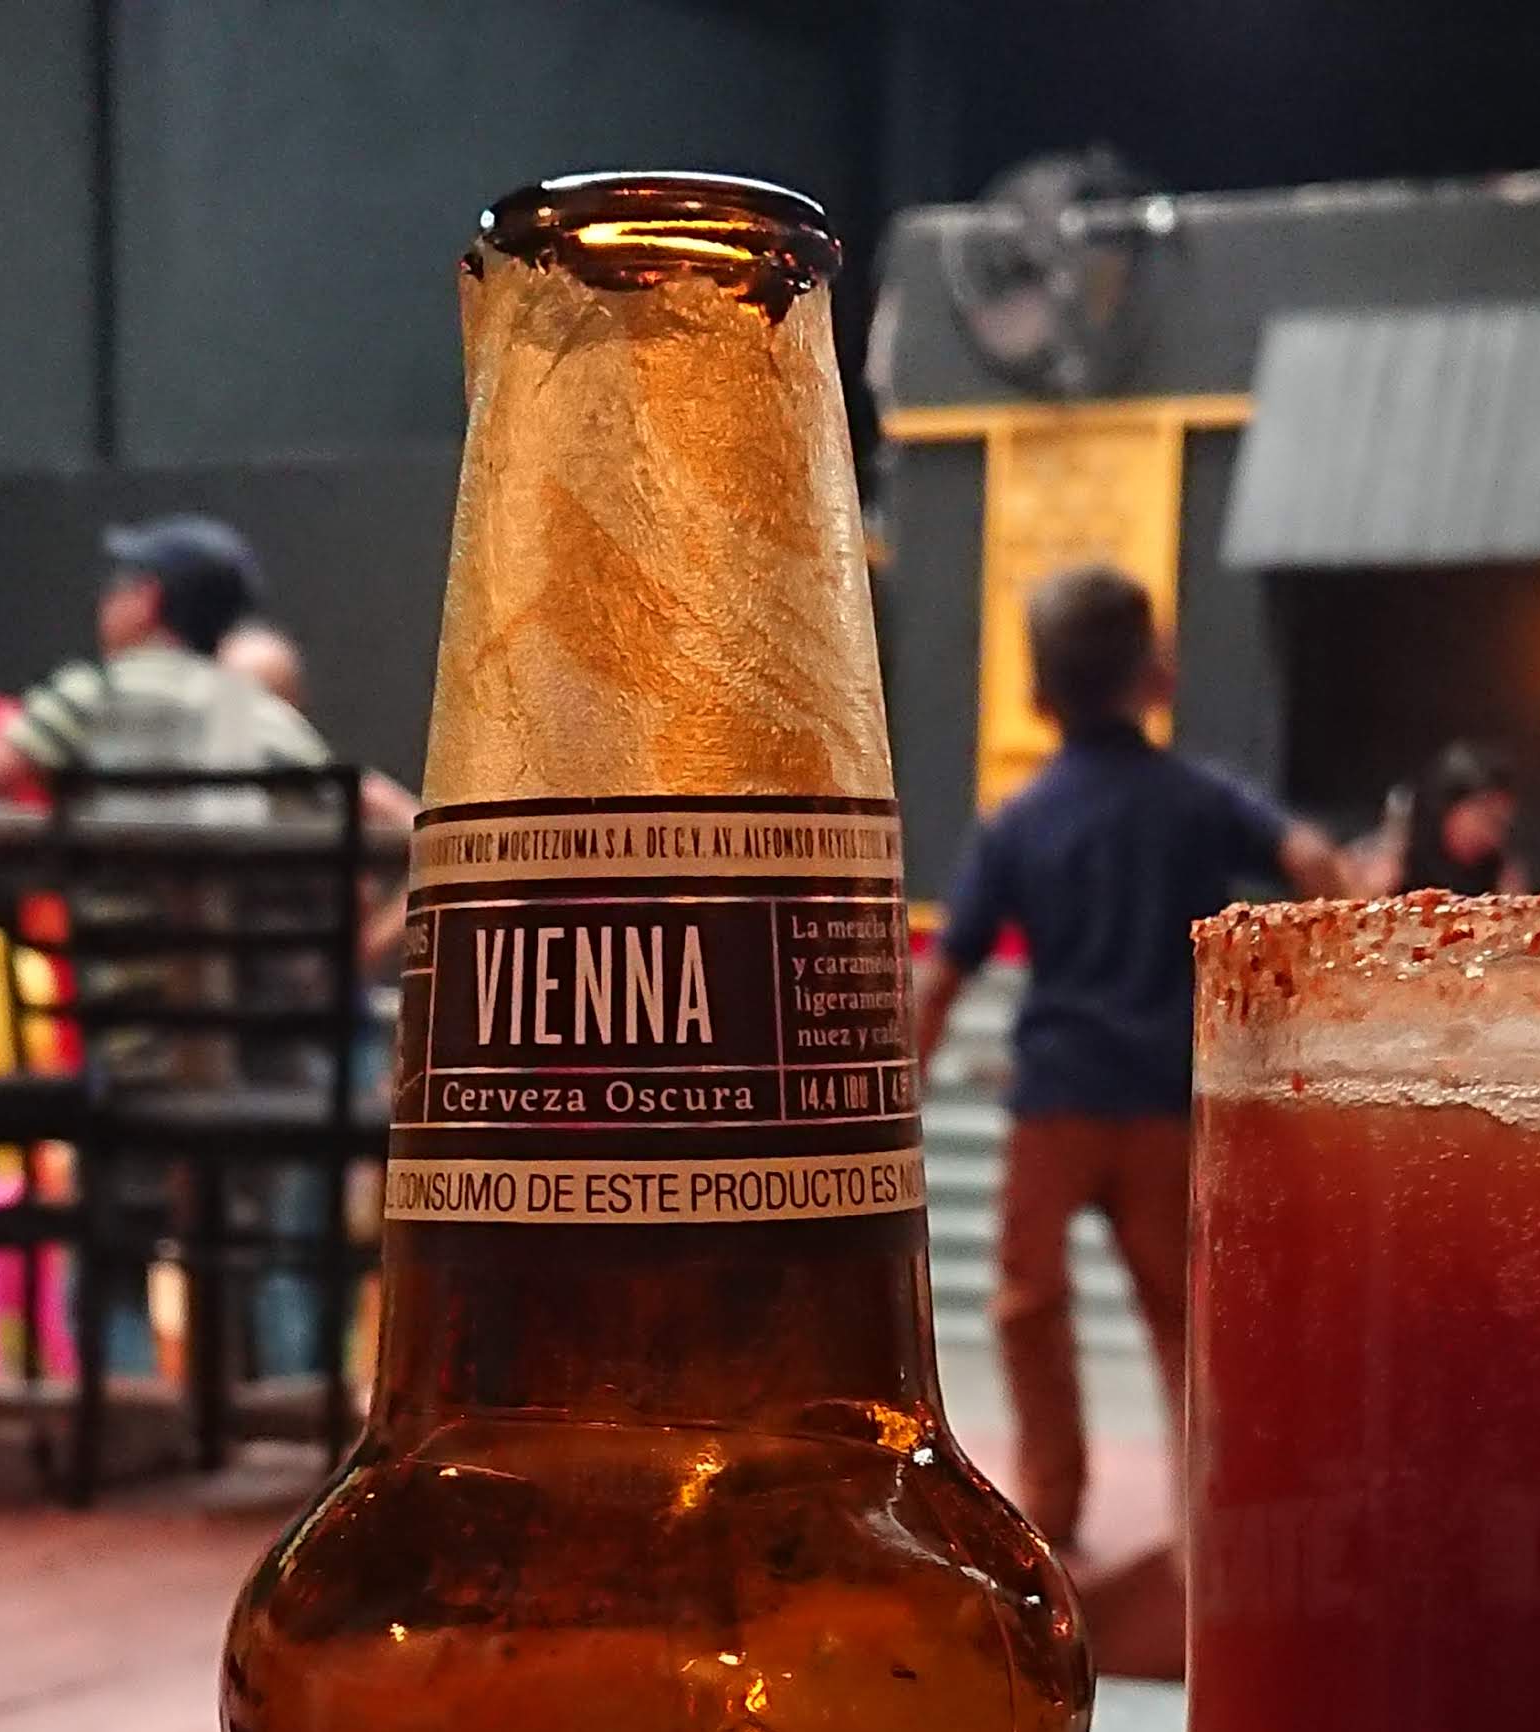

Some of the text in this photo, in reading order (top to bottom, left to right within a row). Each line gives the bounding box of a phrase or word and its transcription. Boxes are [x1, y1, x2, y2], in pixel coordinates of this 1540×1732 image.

[498, 828, 600, 863] MOCTEZUMA
[646, 826, 668, 859] DE
[744, 826, 813, 859] ALFONSO
[792, 915, 819, 939] La
[476, 925, 712, 1045] VIENNA
[792, 957, 806, 981] y
[798, 1027, 850, 1046] nuez
[442, 1081, 754, 1112] Cerveza Oscura
[801, 1075, 836, 1111] 14.4
[398, 1172, 516, 1211] CONSUMO
[528, 1173, 576, 1213] DE
[586, 1173, 680, 1214] ESTE
[691, 1167, 865, 1212] PRODUCTO
[872, 1164, 897, 1203] ES
